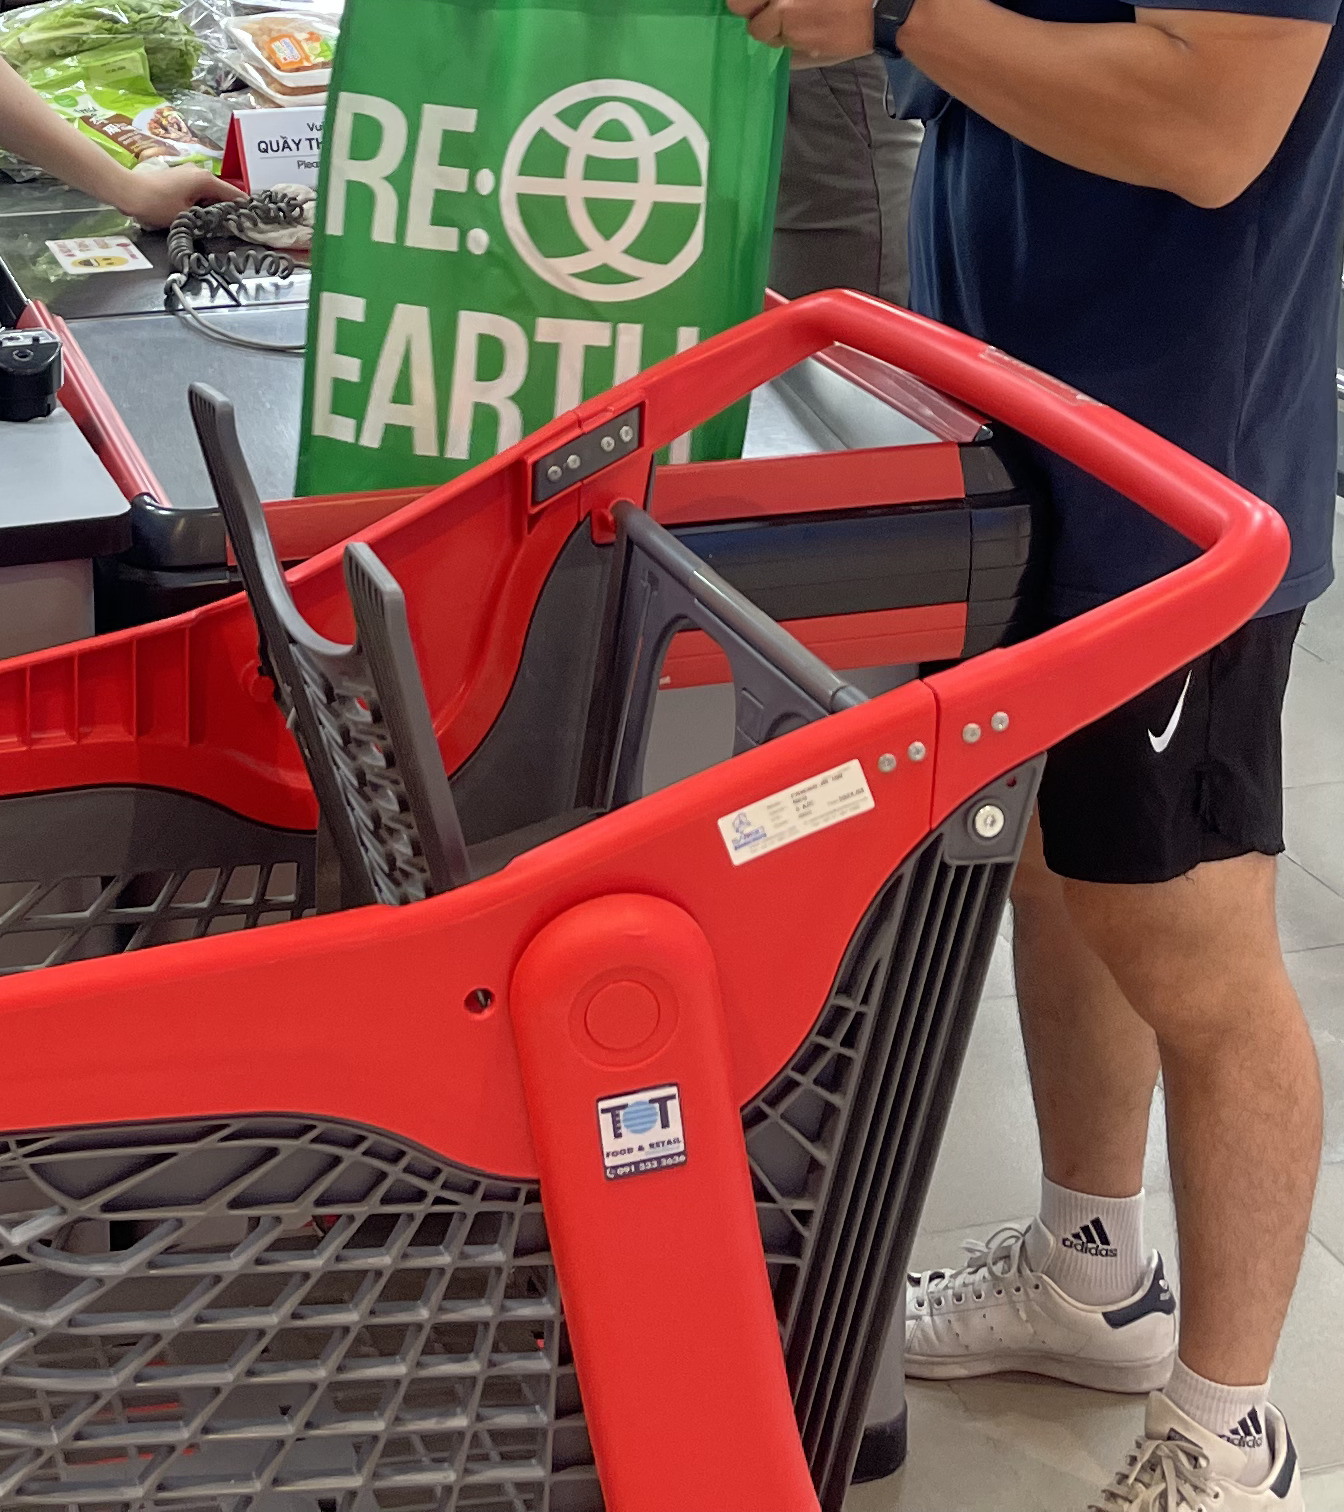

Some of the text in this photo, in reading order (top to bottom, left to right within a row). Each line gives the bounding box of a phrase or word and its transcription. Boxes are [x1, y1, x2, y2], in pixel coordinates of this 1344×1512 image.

[257, 135, 302, 154] QUẦY
[324, 90, 496, 257] RE:
[606, 1147, 634, 1158] FOOD
[1062, 1237, 1118, 1258] adidas
